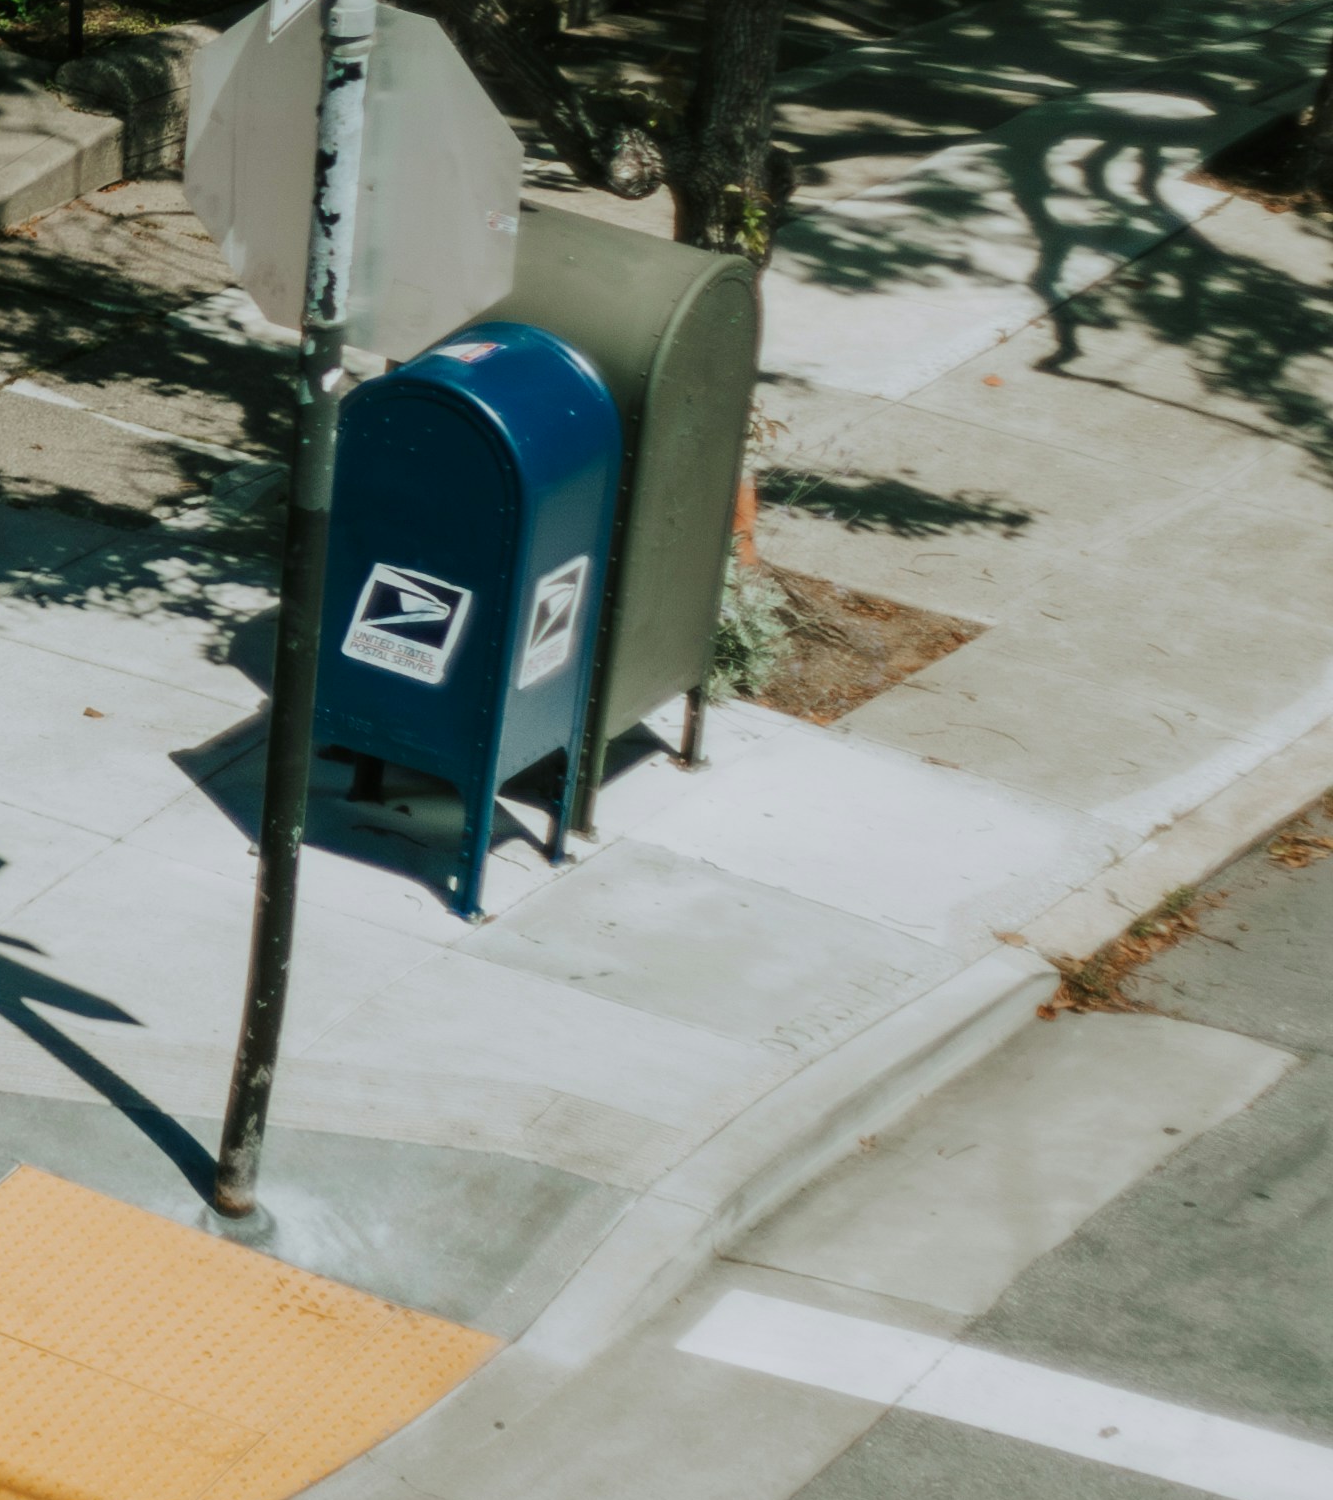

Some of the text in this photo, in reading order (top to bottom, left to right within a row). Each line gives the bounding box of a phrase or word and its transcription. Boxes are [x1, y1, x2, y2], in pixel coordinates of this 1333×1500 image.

[349, 640, 436, 677] POSTAL SERVICE
[353, 630, 435, 663] UNITED STATES
